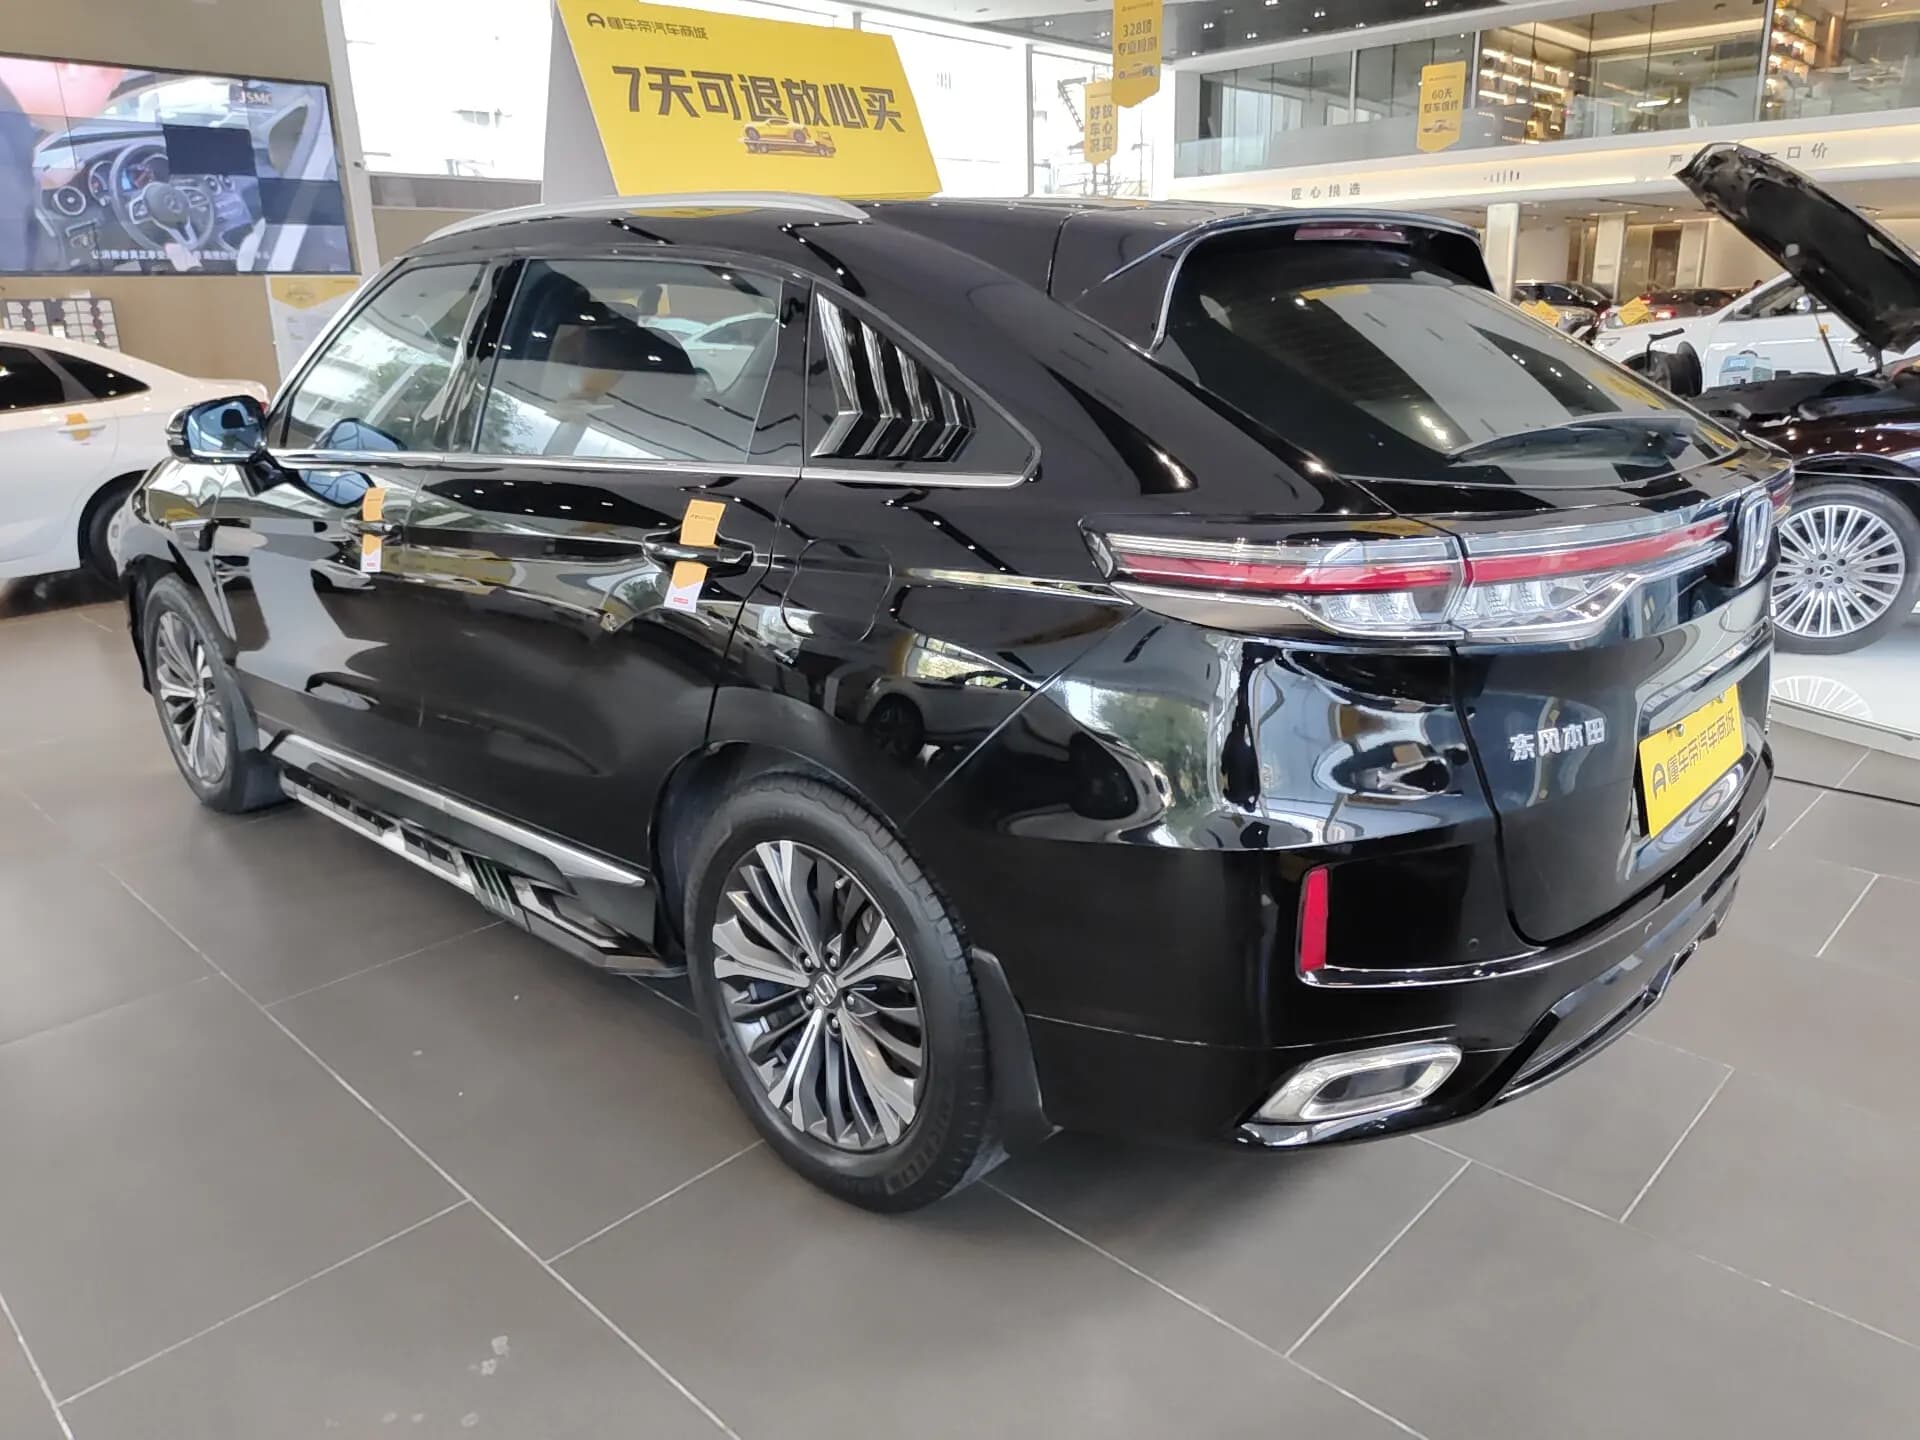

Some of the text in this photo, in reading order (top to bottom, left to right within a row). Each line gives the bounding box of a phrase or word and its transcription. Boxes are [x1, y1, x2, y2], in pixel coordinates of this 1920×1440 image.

[612, 65, 905, 133] 7天可退放心买
[1431, 88, 1453, 100] 60天
[1510, 717, 1605, 762] 东风本田
